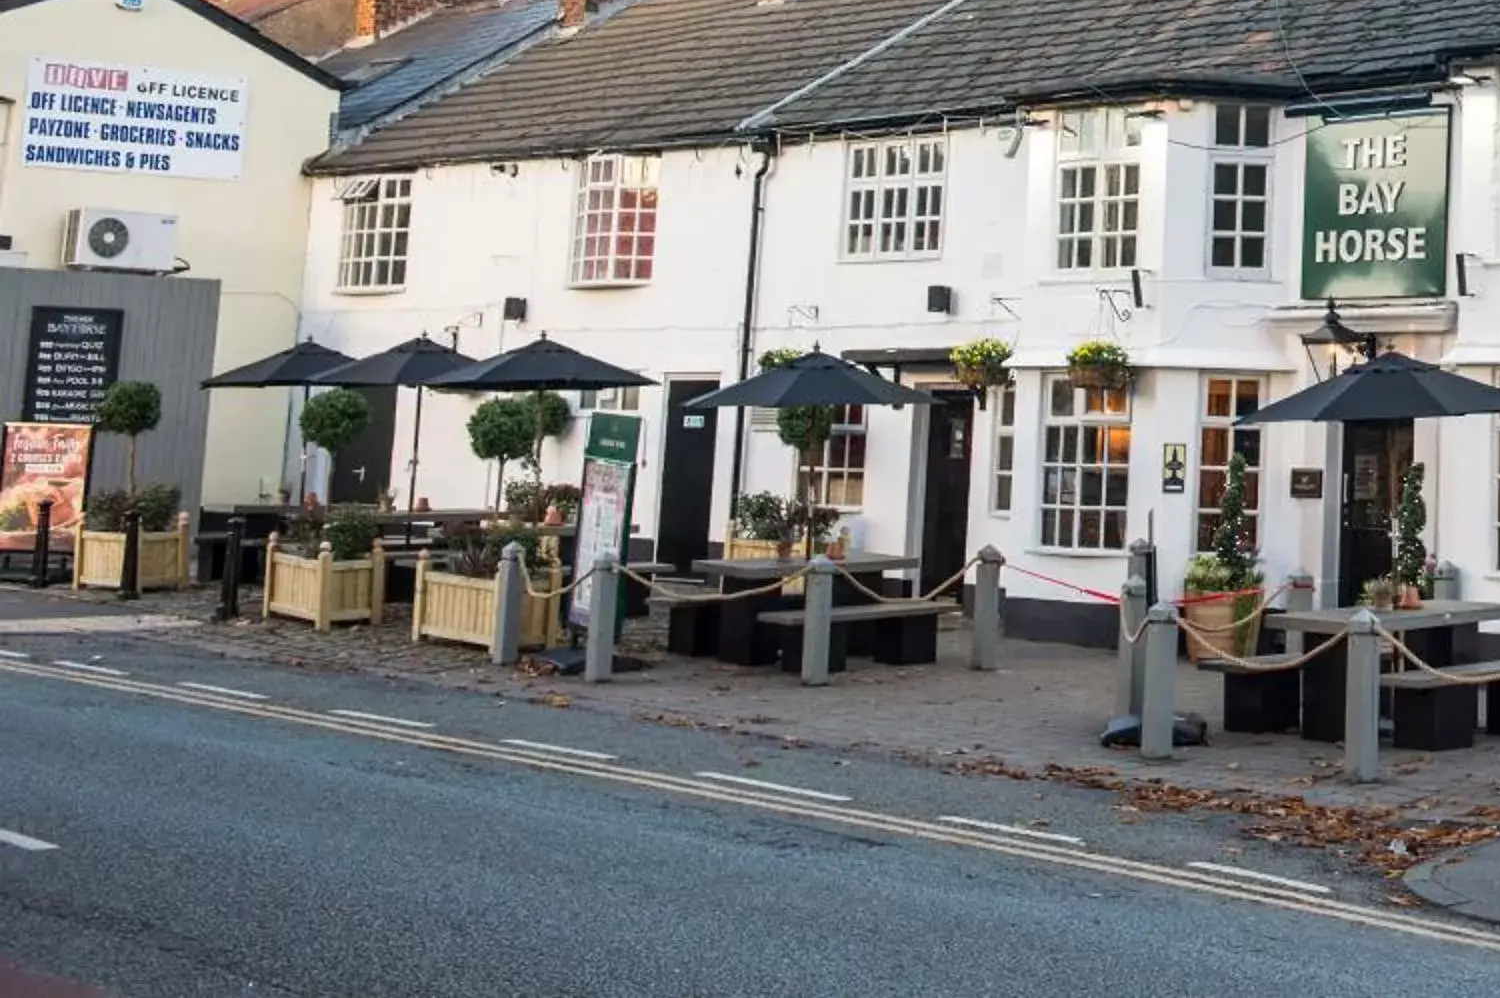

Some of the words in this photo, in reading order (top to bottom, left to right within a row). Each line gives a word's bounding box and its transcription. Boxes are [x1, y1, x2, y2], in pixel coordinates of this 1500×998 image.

[32, 92, 56, 110] OFF
[60, 94, 117, 116] LICENCE
[126, 100, 217, 125] NEWSAGENTS
[137, 82, 168, 94] OFF
[173, 84, 239, 102] LICENCE
[29, 117, 91, 138] PAYZONE
[101, 123, 177, 146] GROCERIES
[185, 131, 240, 151] SNACKS
[25, 144, 121, 167] SANDWICHES
[125, 152, 135, 168] &
[139, 153, 171, 171] PIES
[1342, 134, 1407, 170] THE
[1338, 181, 1405, 215] BAY
[1315, 227, 1427, 263] HORSE
